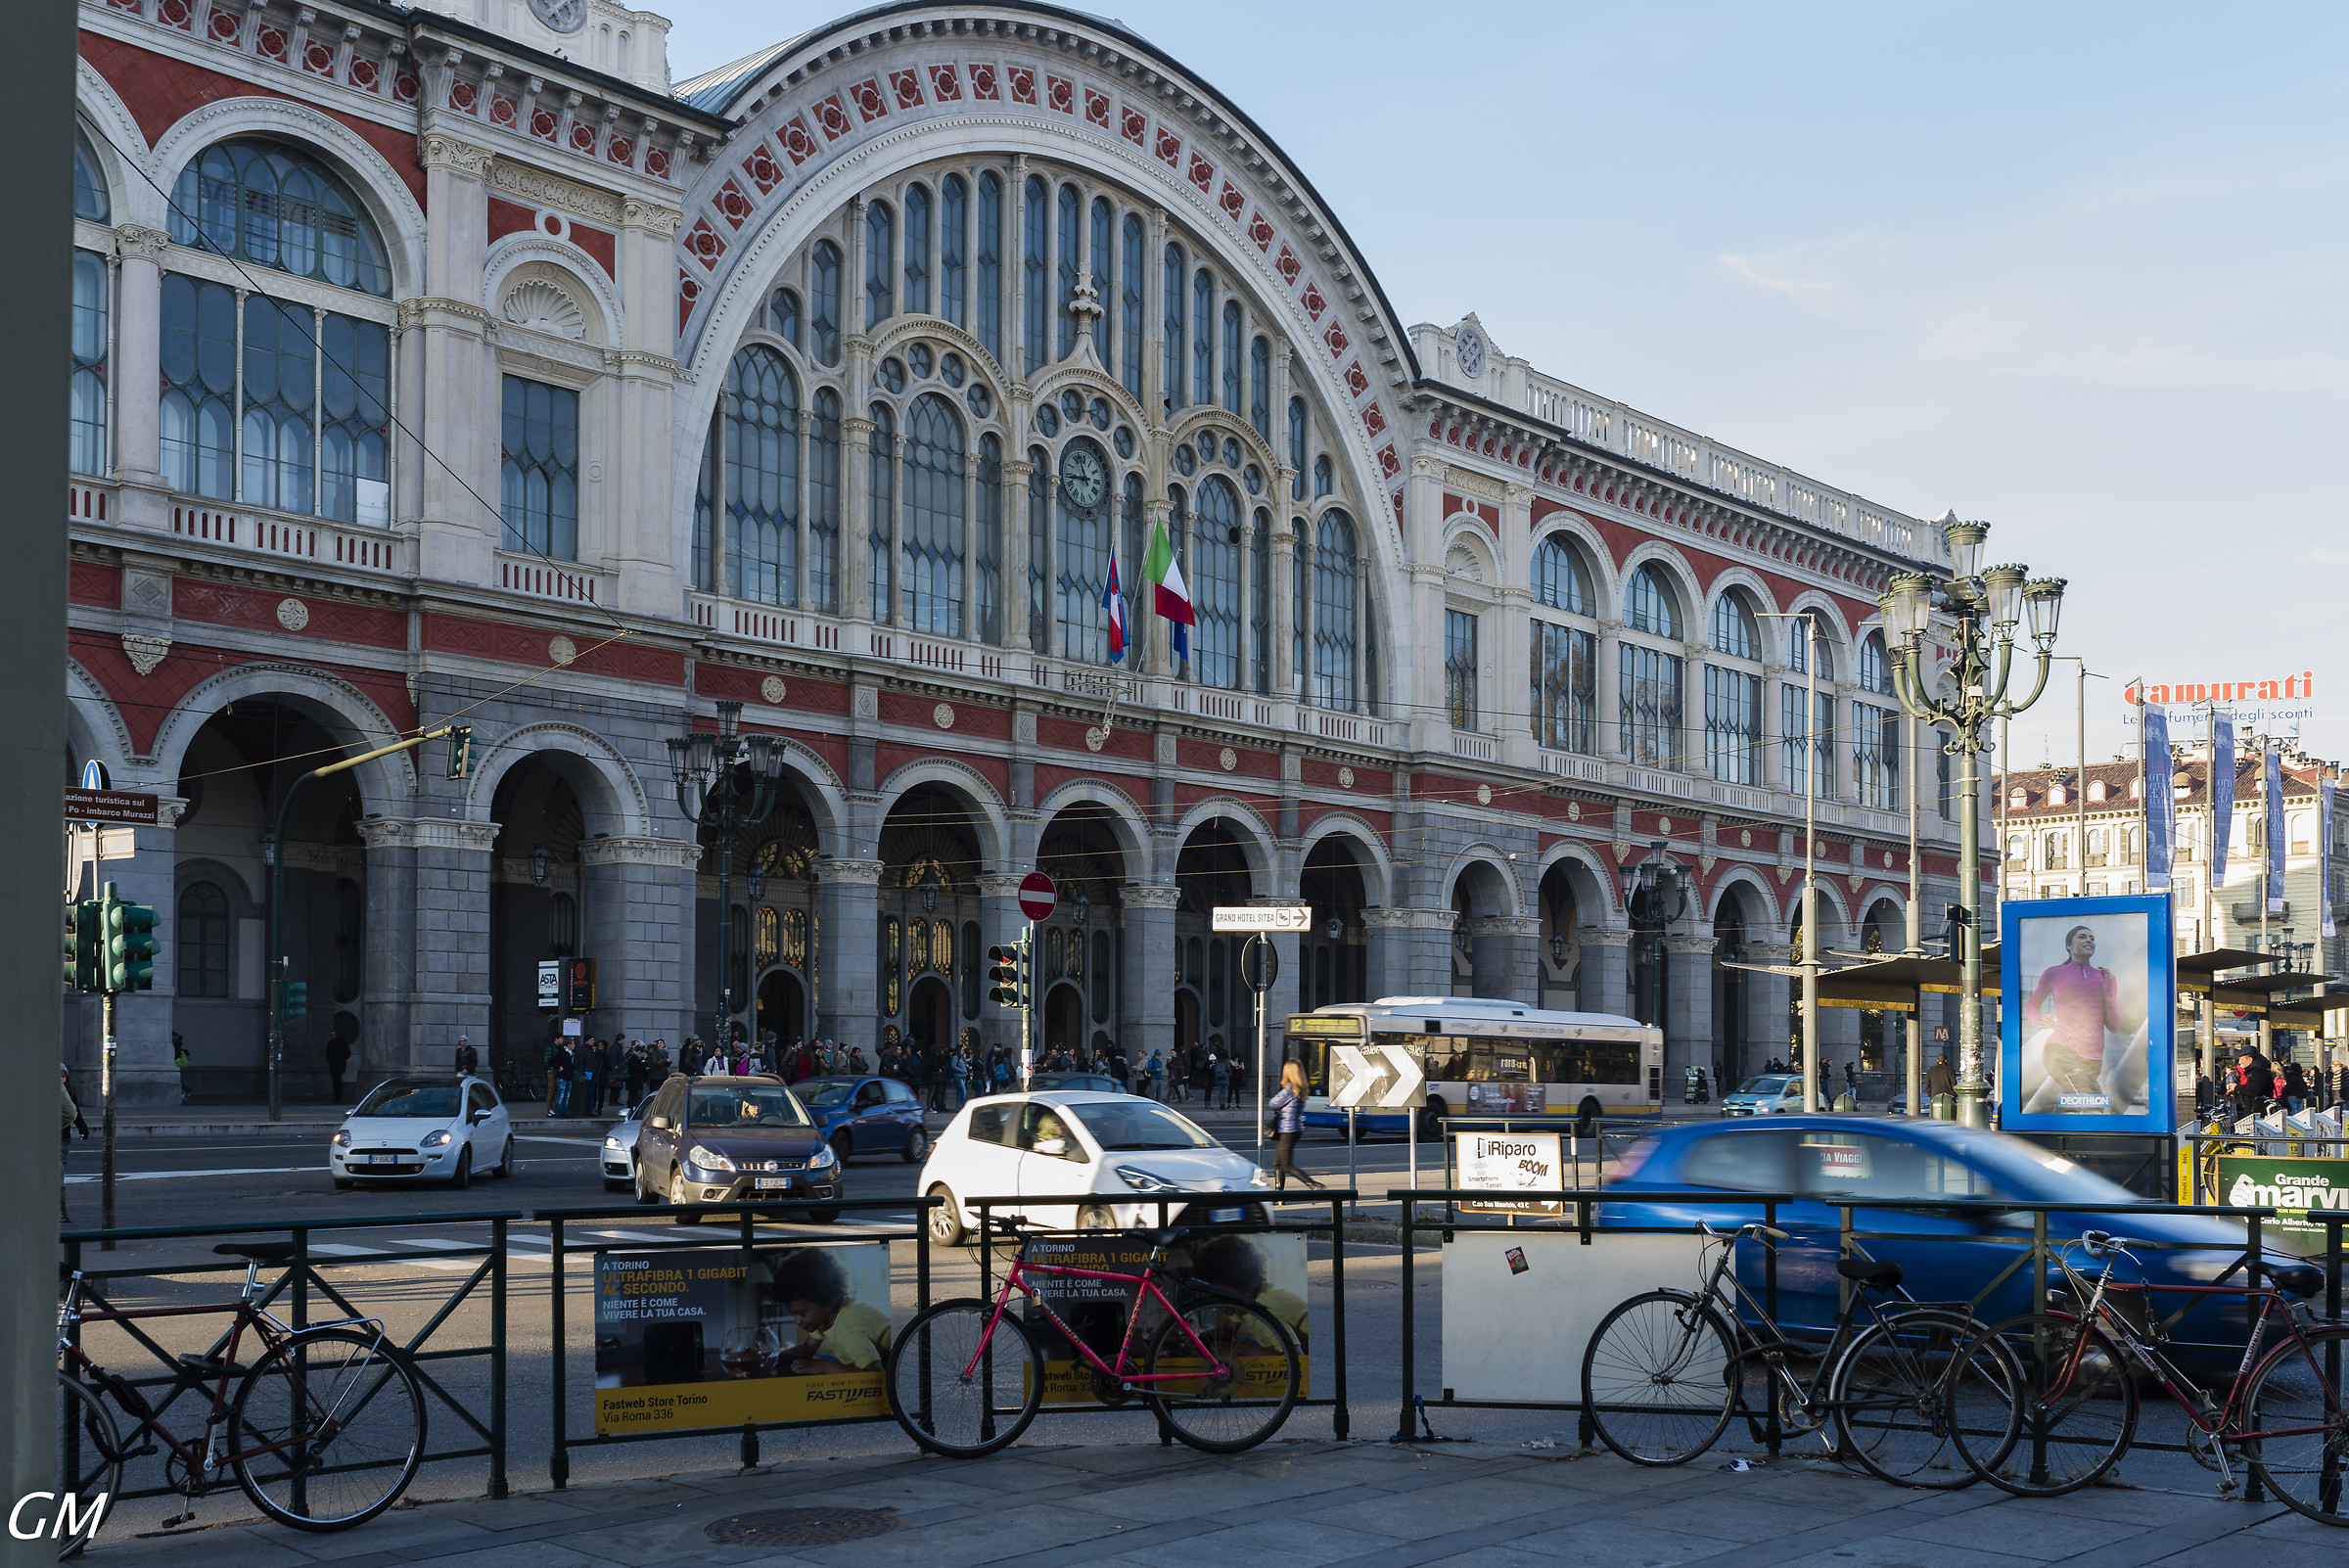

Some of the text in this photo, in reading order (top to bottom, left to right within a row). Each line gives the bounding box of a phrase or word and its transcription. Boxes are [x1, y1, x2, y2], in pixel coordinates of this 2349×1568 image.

[2232, 709, 2265, 723] degli
[2271, 707, 2313, 719] sconti
[66, 794, 93, 803] azione
[95, 796, 130, 806] turistica
[86, 807, 121, 816] imbarco
[122, 809, 155, 819] Murazzi
[1215, 913, 1275, 922] GRAND HOTEL SITEA
[539, 974, 558, 985] ASTA
[2059, 1096, 2109, 1105] DECATHLON
[1488, 1140, 1537, 1159] iRiparo
[1518, 1159, 1548, 1176] BOOM
[2275, 1173, 2329, 1187] Grande
[1040, 1244, 1075, 1253] TORINO
[1032, 1253, 1110, 1265] ULTRAFIBRA
[1110, 1253, 1117, 1263] 1
[602, 1261, 650, 1270] A TORINO
[603, 1267, 749, 1283] ULTRAFIBRA 1 GIGABIT
[602, 1281, 689, 1296] AL SECONDO.
[1032, 1277, 1102, 1289] NIENTE È COME
[1067, 1289, 1079, 1298] LA
[1081, 1288, 1100, 1298] TUA
[1102, 1288, 1128, 1297] CASA.
[603, 1297, 678, 1310] NIENTE È COME
[603, 1307, 707, 1319] VIVERE LA TUA CASA.
[1050, 1383, 1077, 1393] Roma
[806, 1386, 883, 1403] FASTWEB
[603, 1394, 708, 1410] Fastweb Store Torino
[603, 1408, 673, 1423] Via Roma 336
